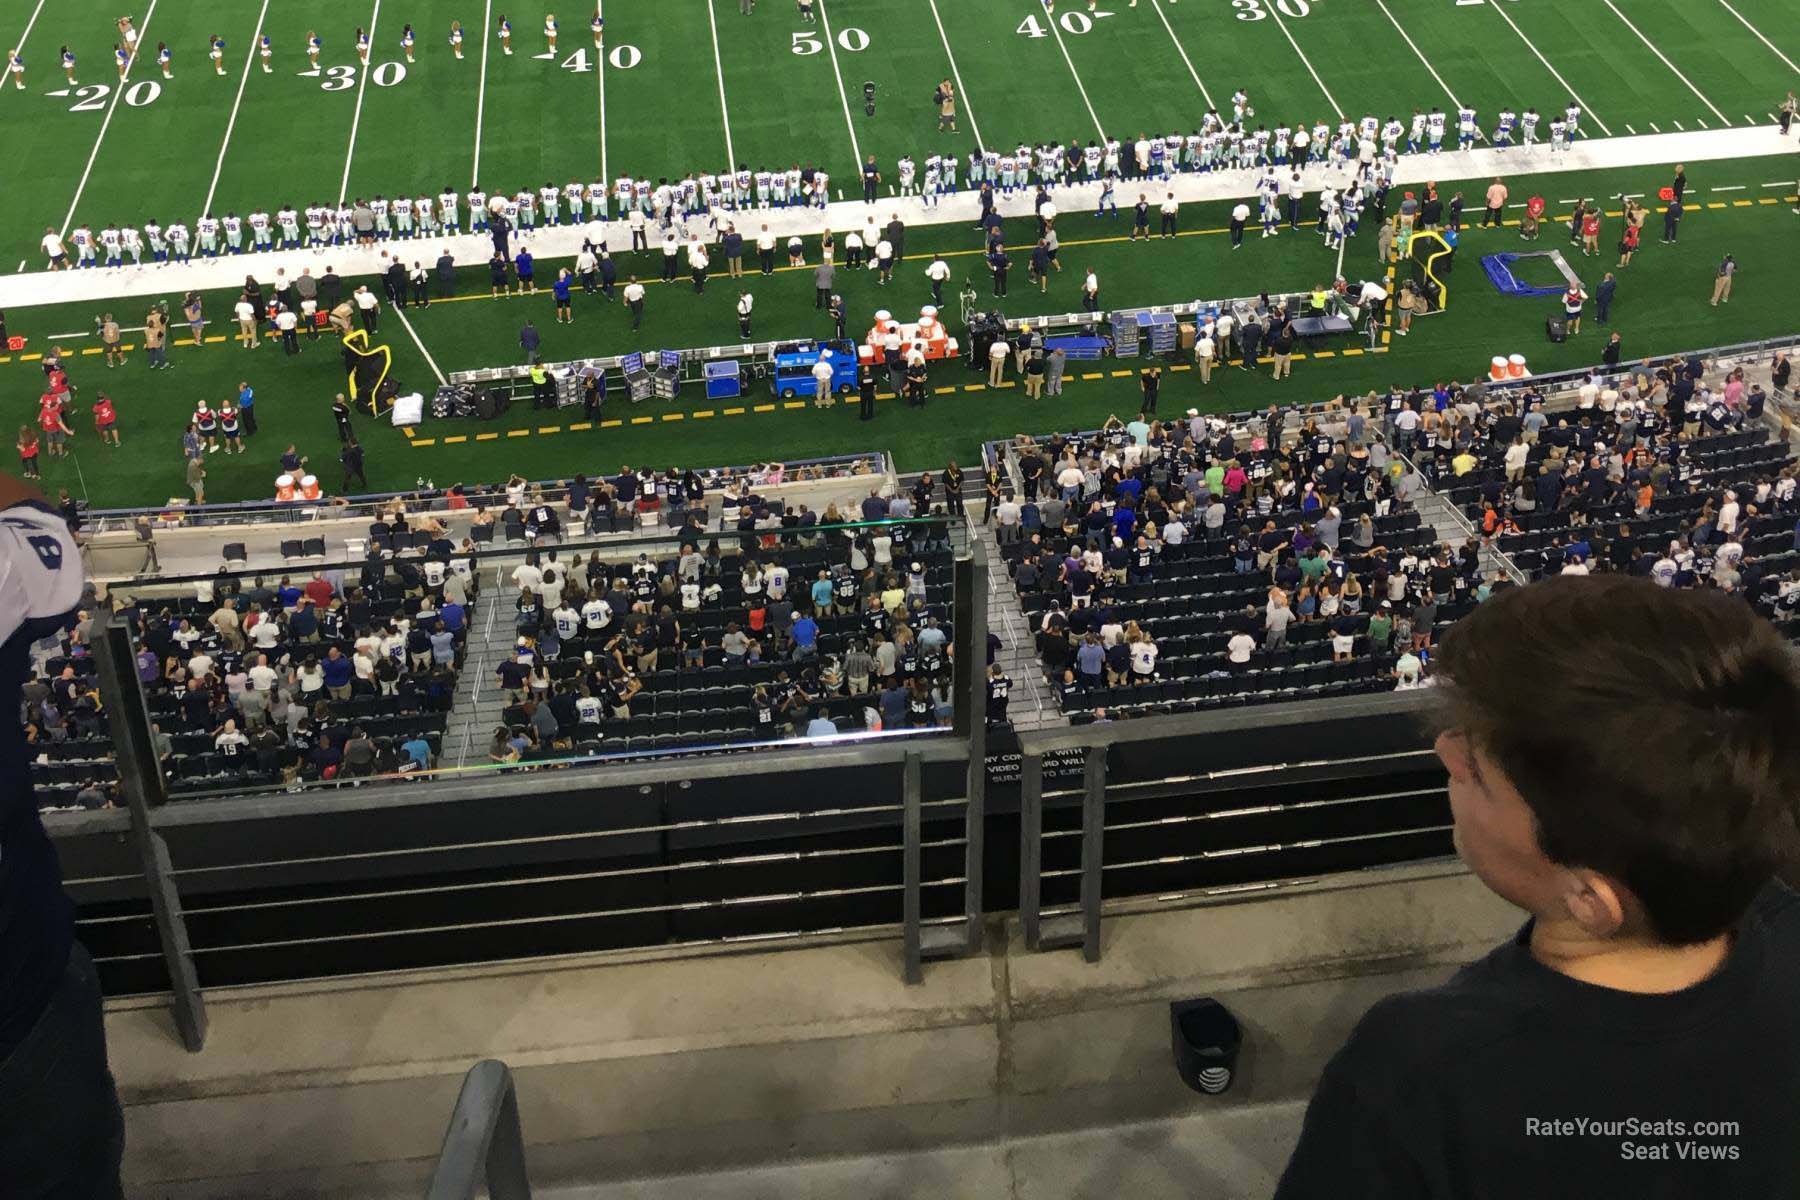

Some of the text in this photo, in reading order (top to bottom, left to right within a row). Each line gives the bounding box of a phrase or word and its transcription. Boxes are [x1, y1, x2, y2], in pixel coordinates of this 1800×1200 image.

[1017, 12, 1090, 37] 40
[792, 28, 870, 54] 50
[561, 46, 641, 72] 40
[321, 62, 406, 90] 30
[70, 81, 161, 111] 20
[202, 224, 213, 233] 75
[8, 338, 22, 350] 20
[644, 482, 655, 494] 21
[537, 511, 548, 522] 21
[1138, 555, 1151, 567] 21
[558, 619, 570, 631] 21
[1142, 653, 1150, 664] 4
[992, 686, 1008, 699] 24
[581, 708, 596, 718] 22
[222, 743, 238, 756] 19
[987, 763, 1020, 773] VIDEO
[1042, 770, 1057, 779] TO
